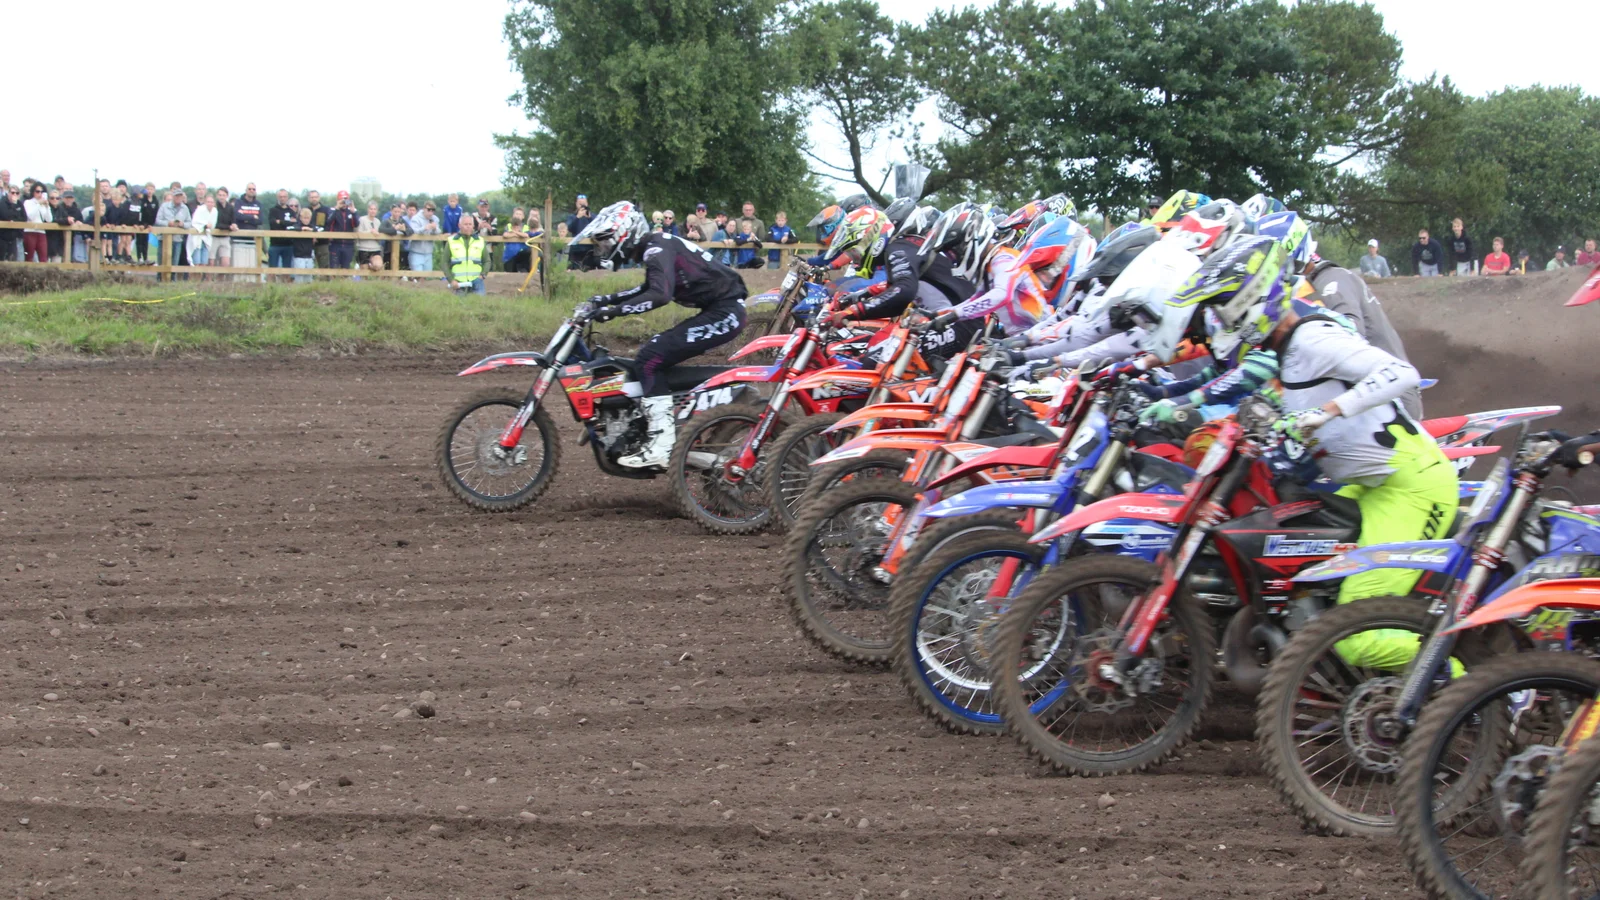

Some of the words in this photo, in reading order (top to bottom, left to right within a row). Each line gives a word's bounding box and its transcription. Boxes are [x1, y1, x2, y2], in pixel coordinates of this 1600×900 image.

[622, 301, 653, 313] FXR
[686, 313, 740, 343] FXR
[695, 386, 734, 411] 474
